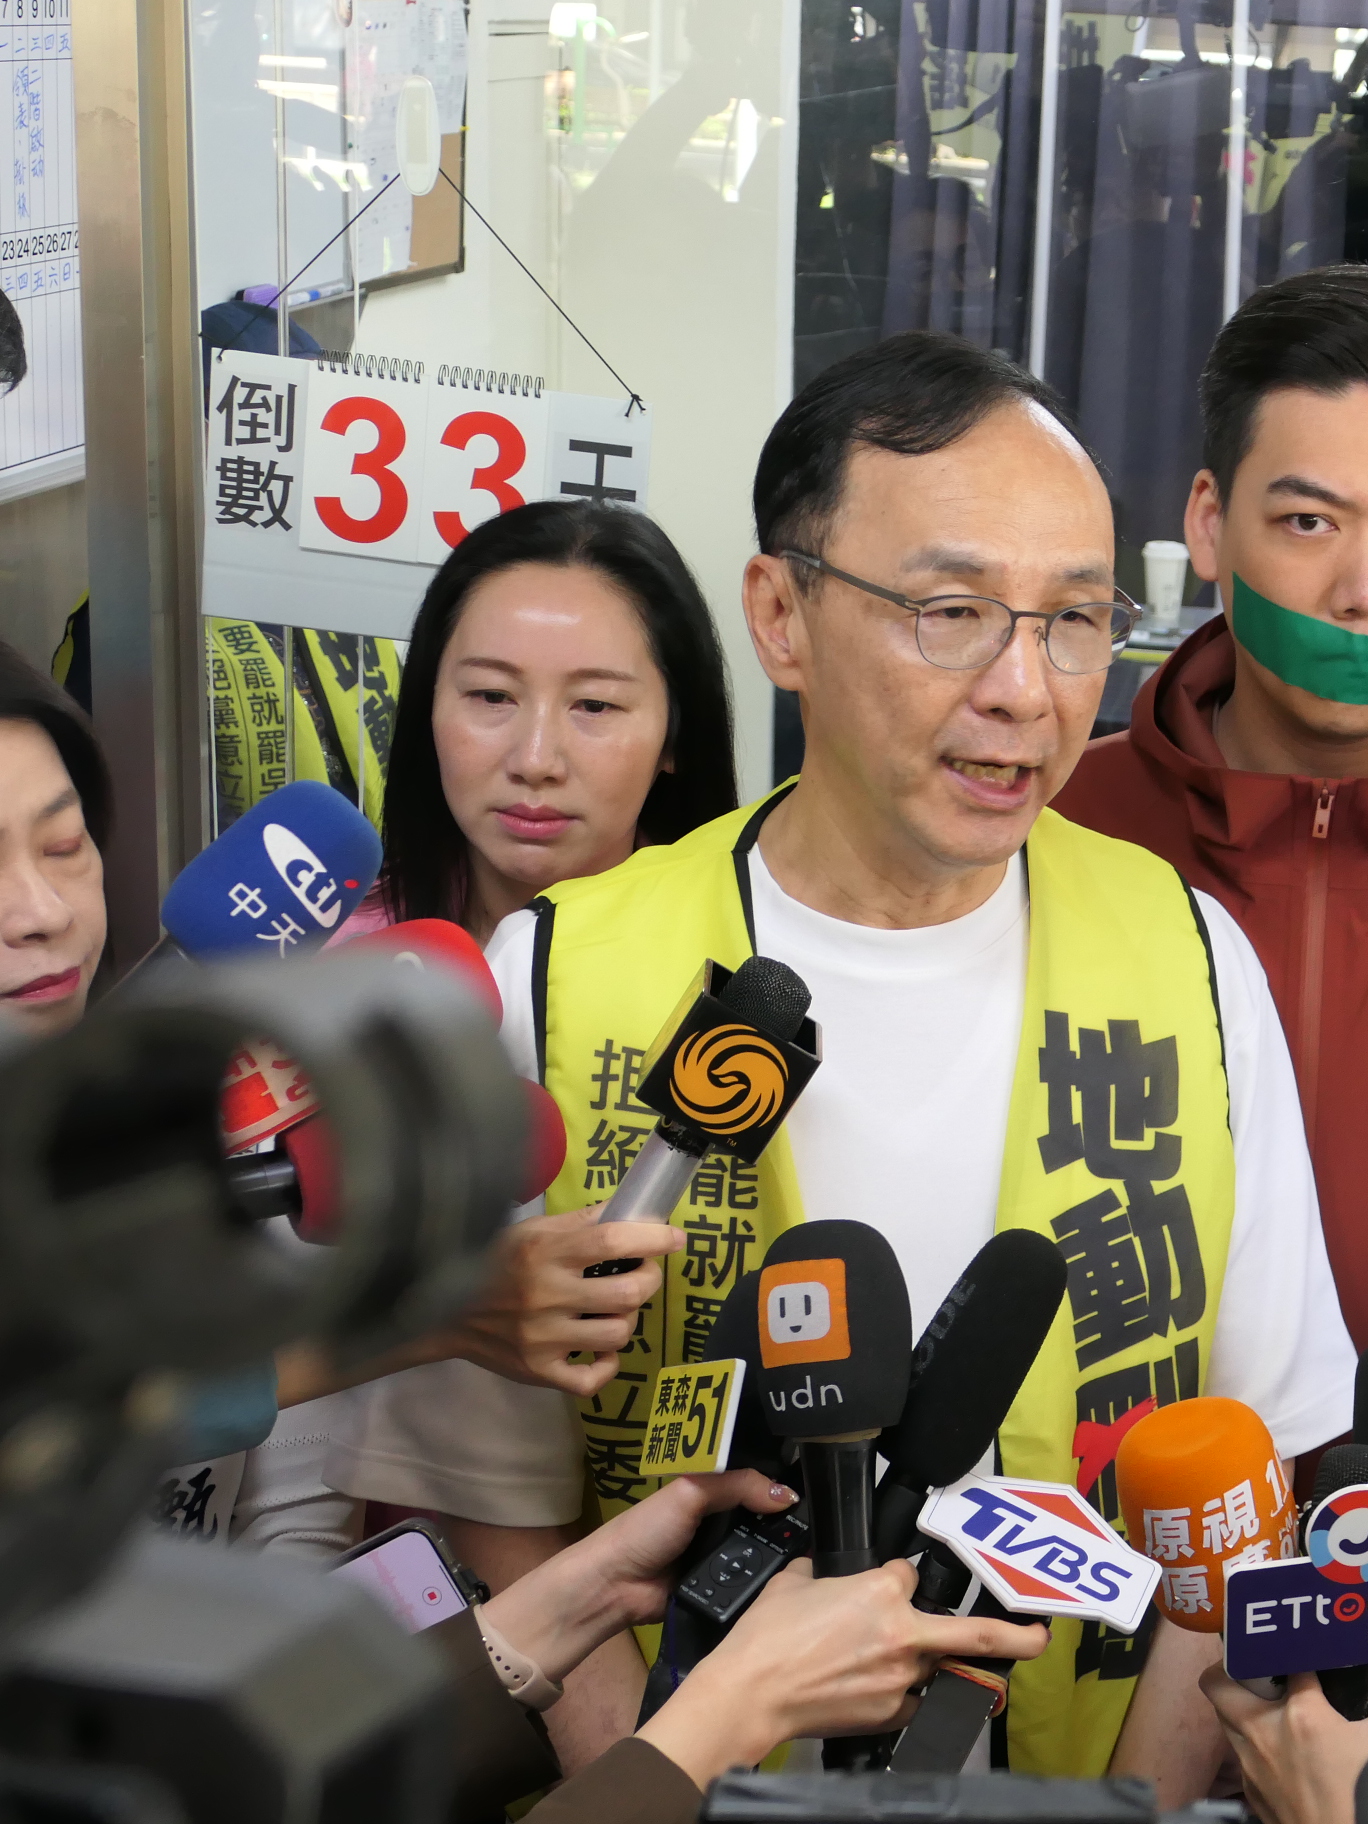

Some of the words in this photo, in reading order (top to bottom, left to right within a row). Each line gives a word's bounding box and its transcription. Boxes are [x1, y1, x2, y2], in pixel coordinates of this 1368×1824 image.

[44, 0, 55, 18] 10
[2, 240, 15, 261] 23
[17, 238, 30, 259] 24
[32, 235, 45, 256] 25
[46, 233, 59, 254] 26
[60, 231, 73, 251] 27
[216, 374, 298, 532] 倒數
[313, 396, 527, 551] 33
[227, 882, 307, 959] 中天
[654, 1373, 692, 1417] 東森
[681, 1371, 730, 1459] 51
[769, 1375, 843, 1412] udn
[645, 1421, 684, 1465] 新聞
[959, 1487, 1133, 1603] TVBS
[1143, 1478, 1260, 1562] 原視
